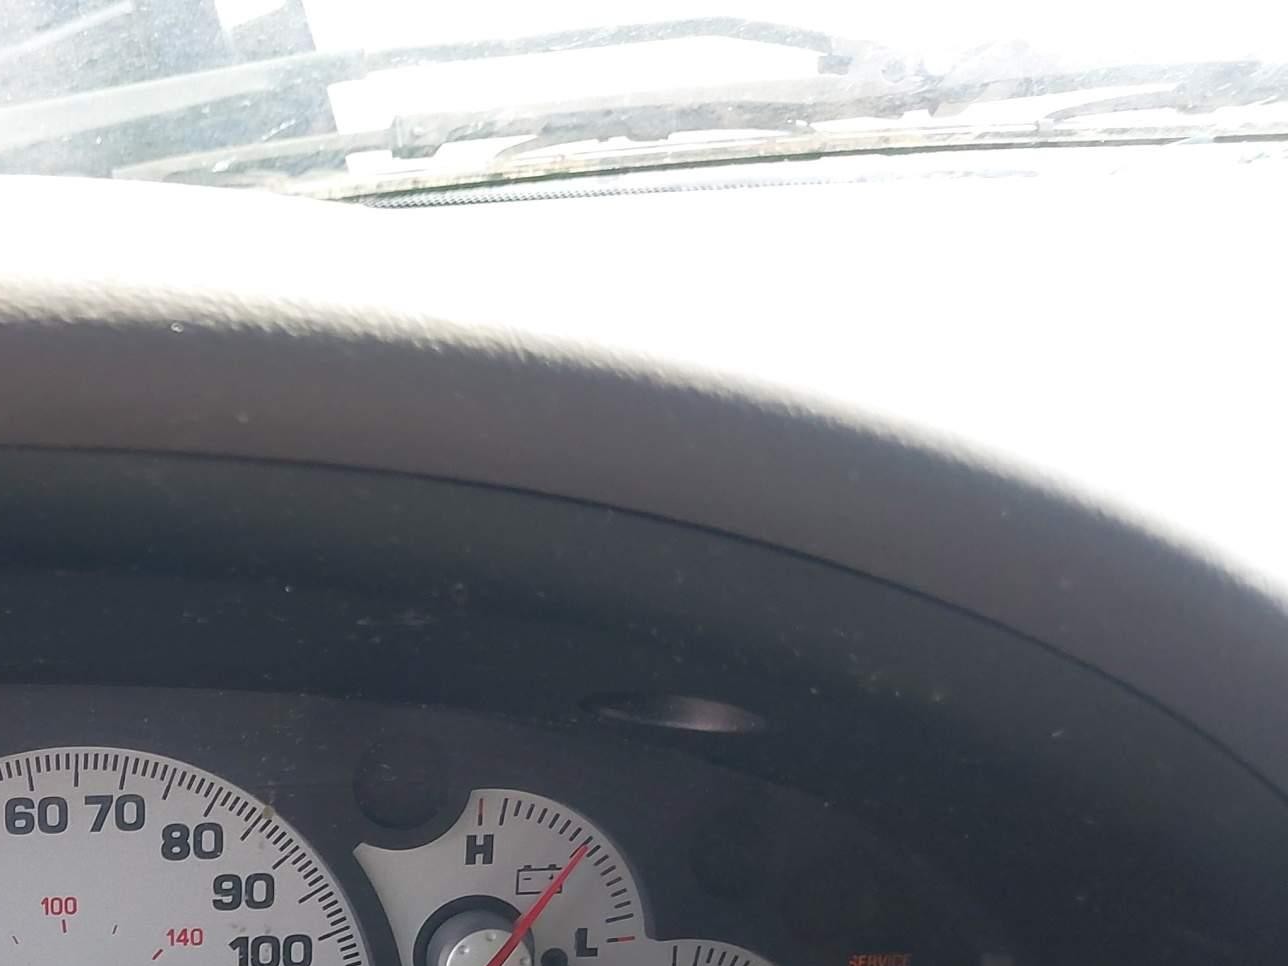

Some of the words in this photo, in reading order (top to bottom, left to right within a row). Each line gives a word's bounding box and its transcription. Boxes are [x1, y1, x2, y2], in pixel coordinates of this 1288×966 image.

[4, 796, 69, 835] 60
[84, 793, 146, 833] 70
[160, 822, 224, 861] 80
[465, 833, 495, 866] H
[40, 896, 78, 916] 100
[212, 872, 275, 911] 90
[166, 928, 204, 947] 140
[574, 927, 599, 958] L
